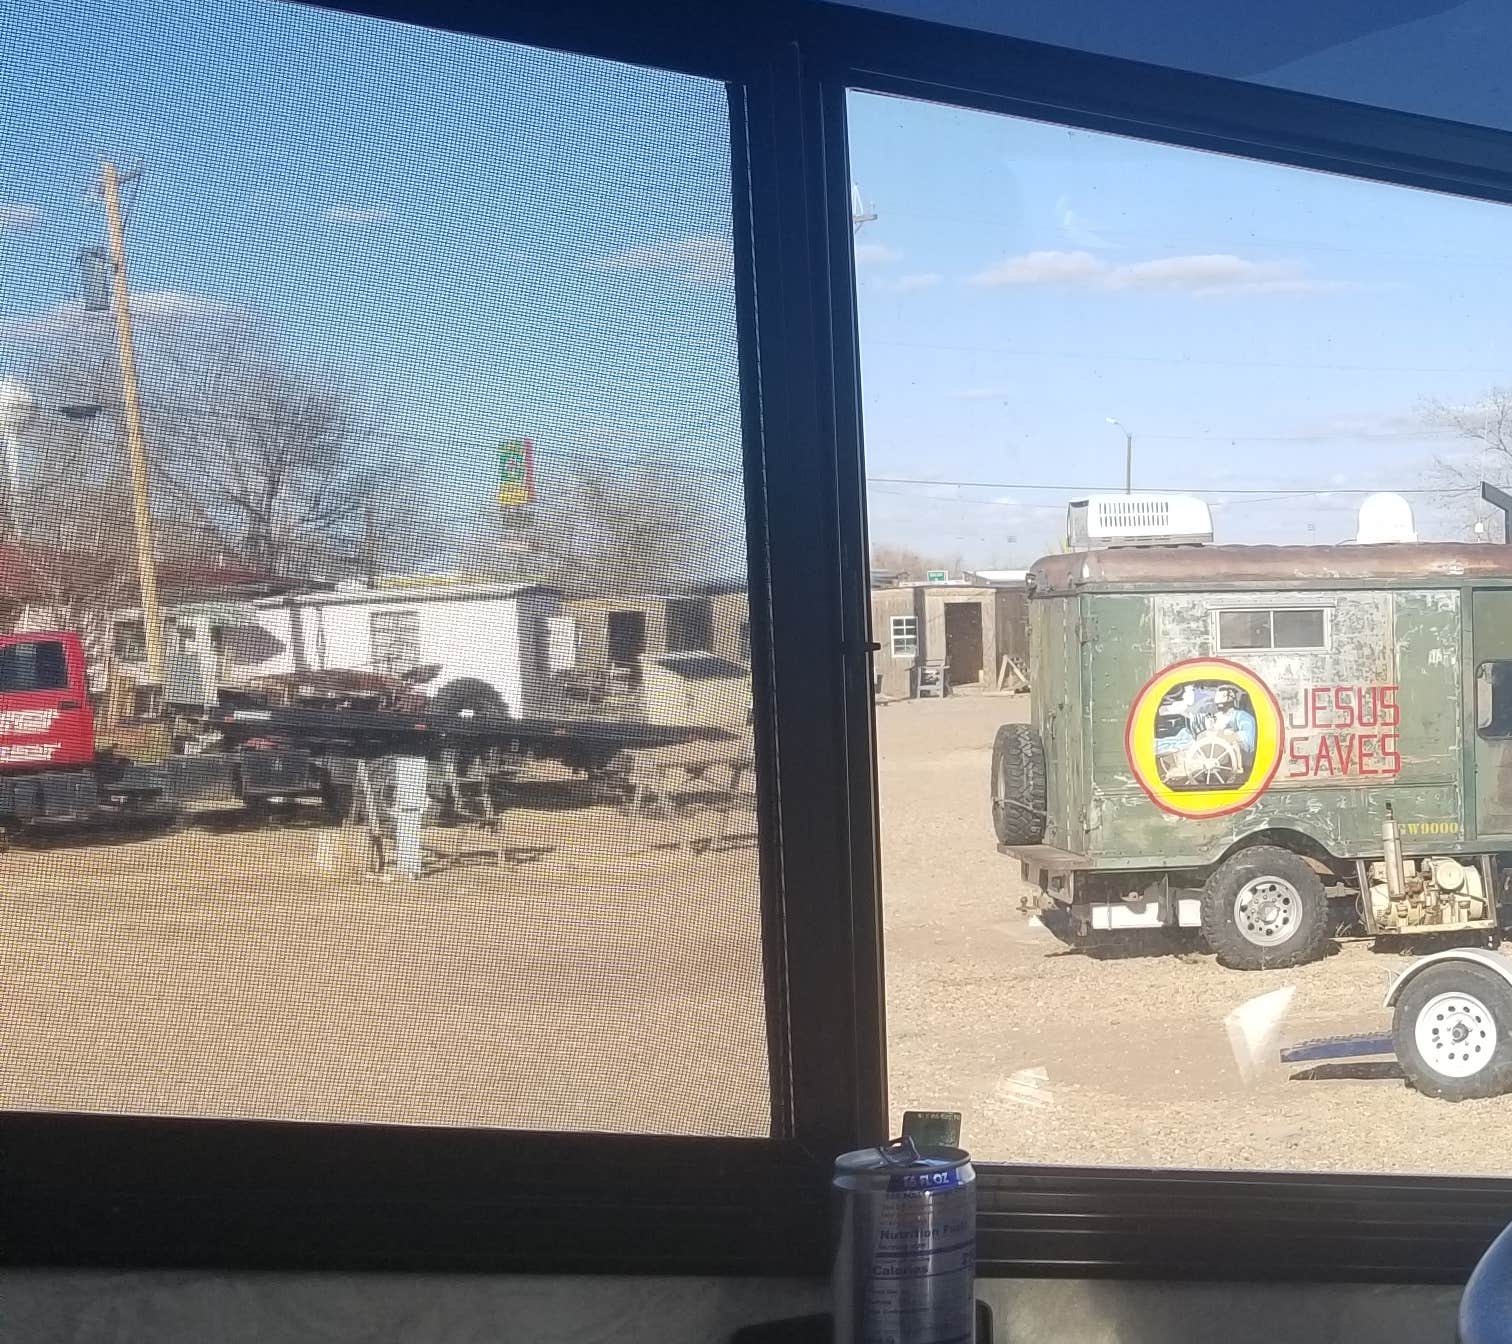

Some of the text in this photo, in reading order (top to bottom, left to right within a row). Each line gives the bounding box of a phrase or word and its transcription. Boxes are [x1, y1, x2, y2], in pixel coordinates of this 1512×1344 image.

[1289, 686, 1400, 729] JESUS
[1289, 734, 1401, 777] SAVES
[919, 1174, 931, 1186] FL
[933, 1172, 950, 1184] OZ
[873, 1264, 929, 1276] Calories
